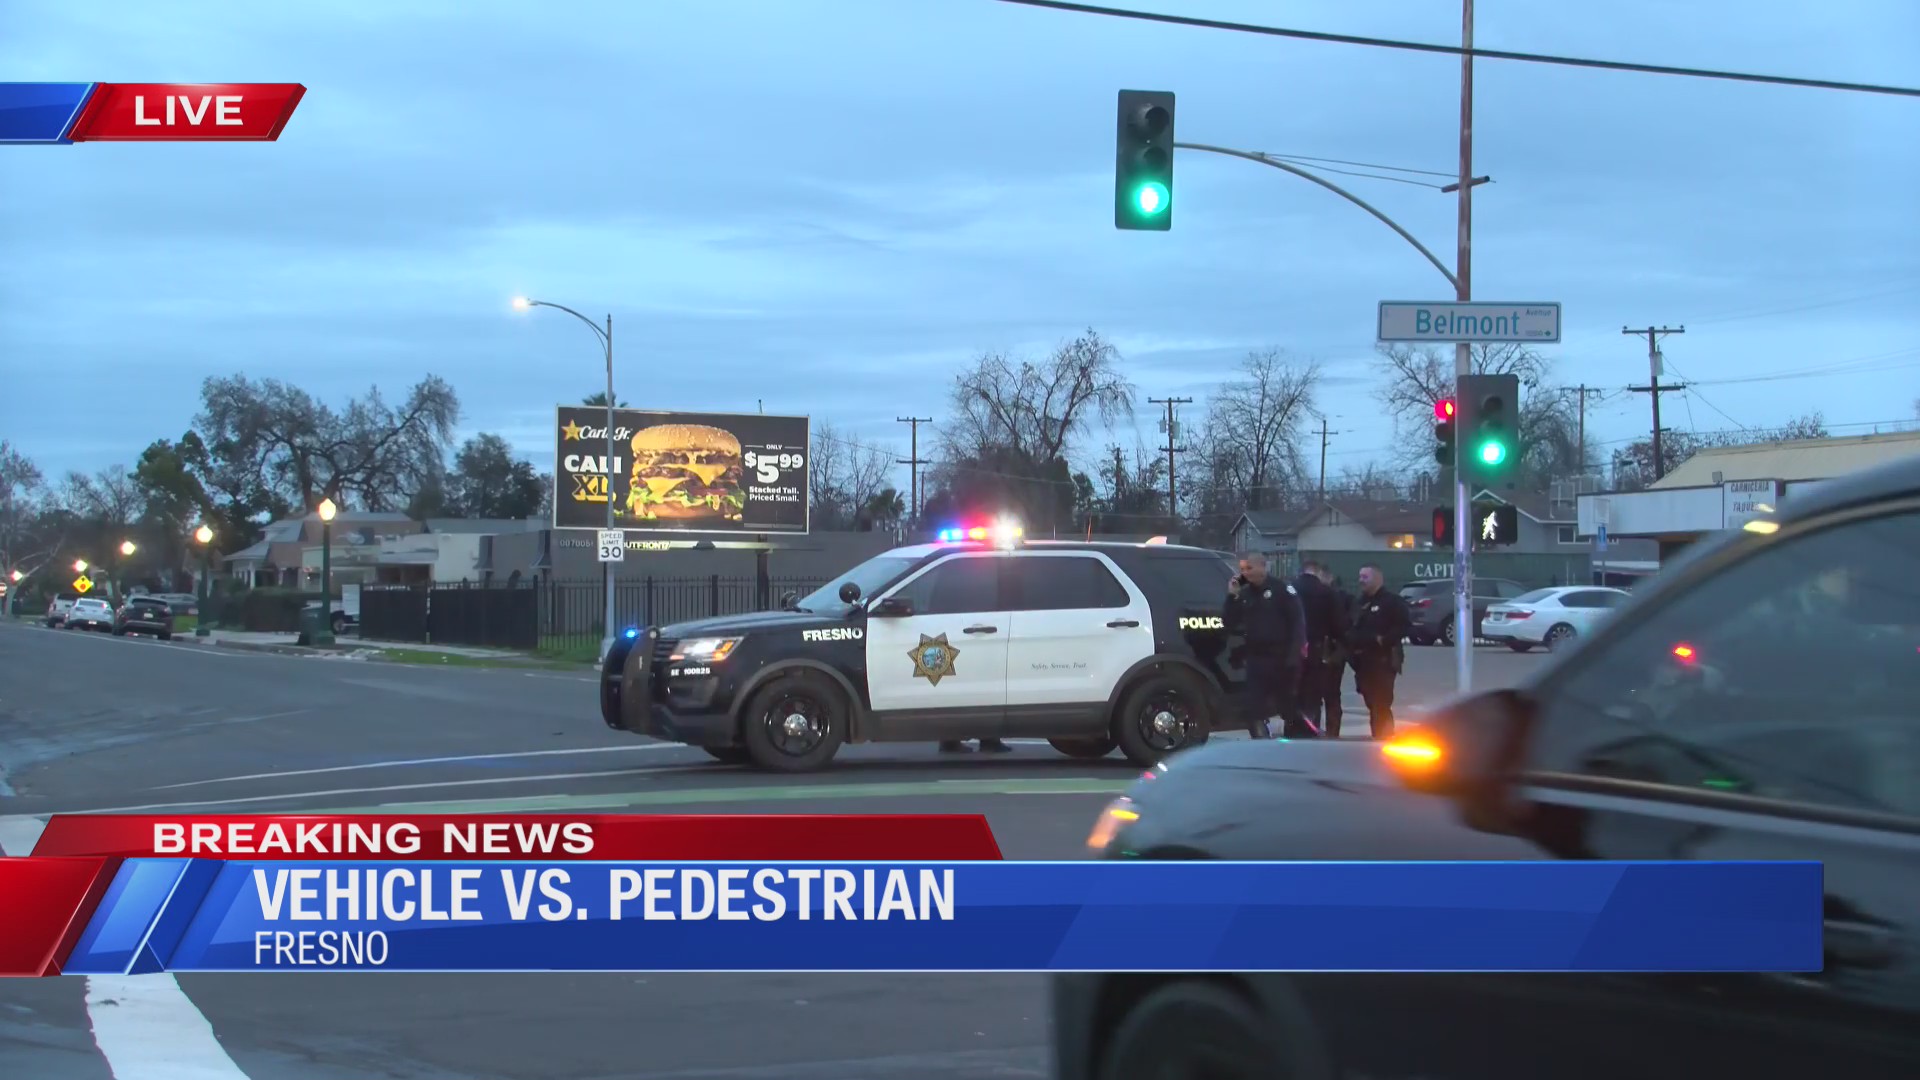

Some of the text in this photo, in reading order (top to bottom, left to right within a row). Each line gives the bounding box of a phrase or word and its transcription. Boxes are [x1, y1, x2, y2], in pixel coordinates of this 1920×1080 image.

[1416, 309, 1520, 335] Belmont
[613, 426, 631, 441] Jr.
[765, 443, 783, 451] ONLY
[564, 454, 622, 474] CALI
[749, 485, 800, 495] Stacked Tall.
[749, 493, 800, 502] Priced Small.
[601, 547, 622, 559] 30
[803, 627, 864, 642] FRESNO
